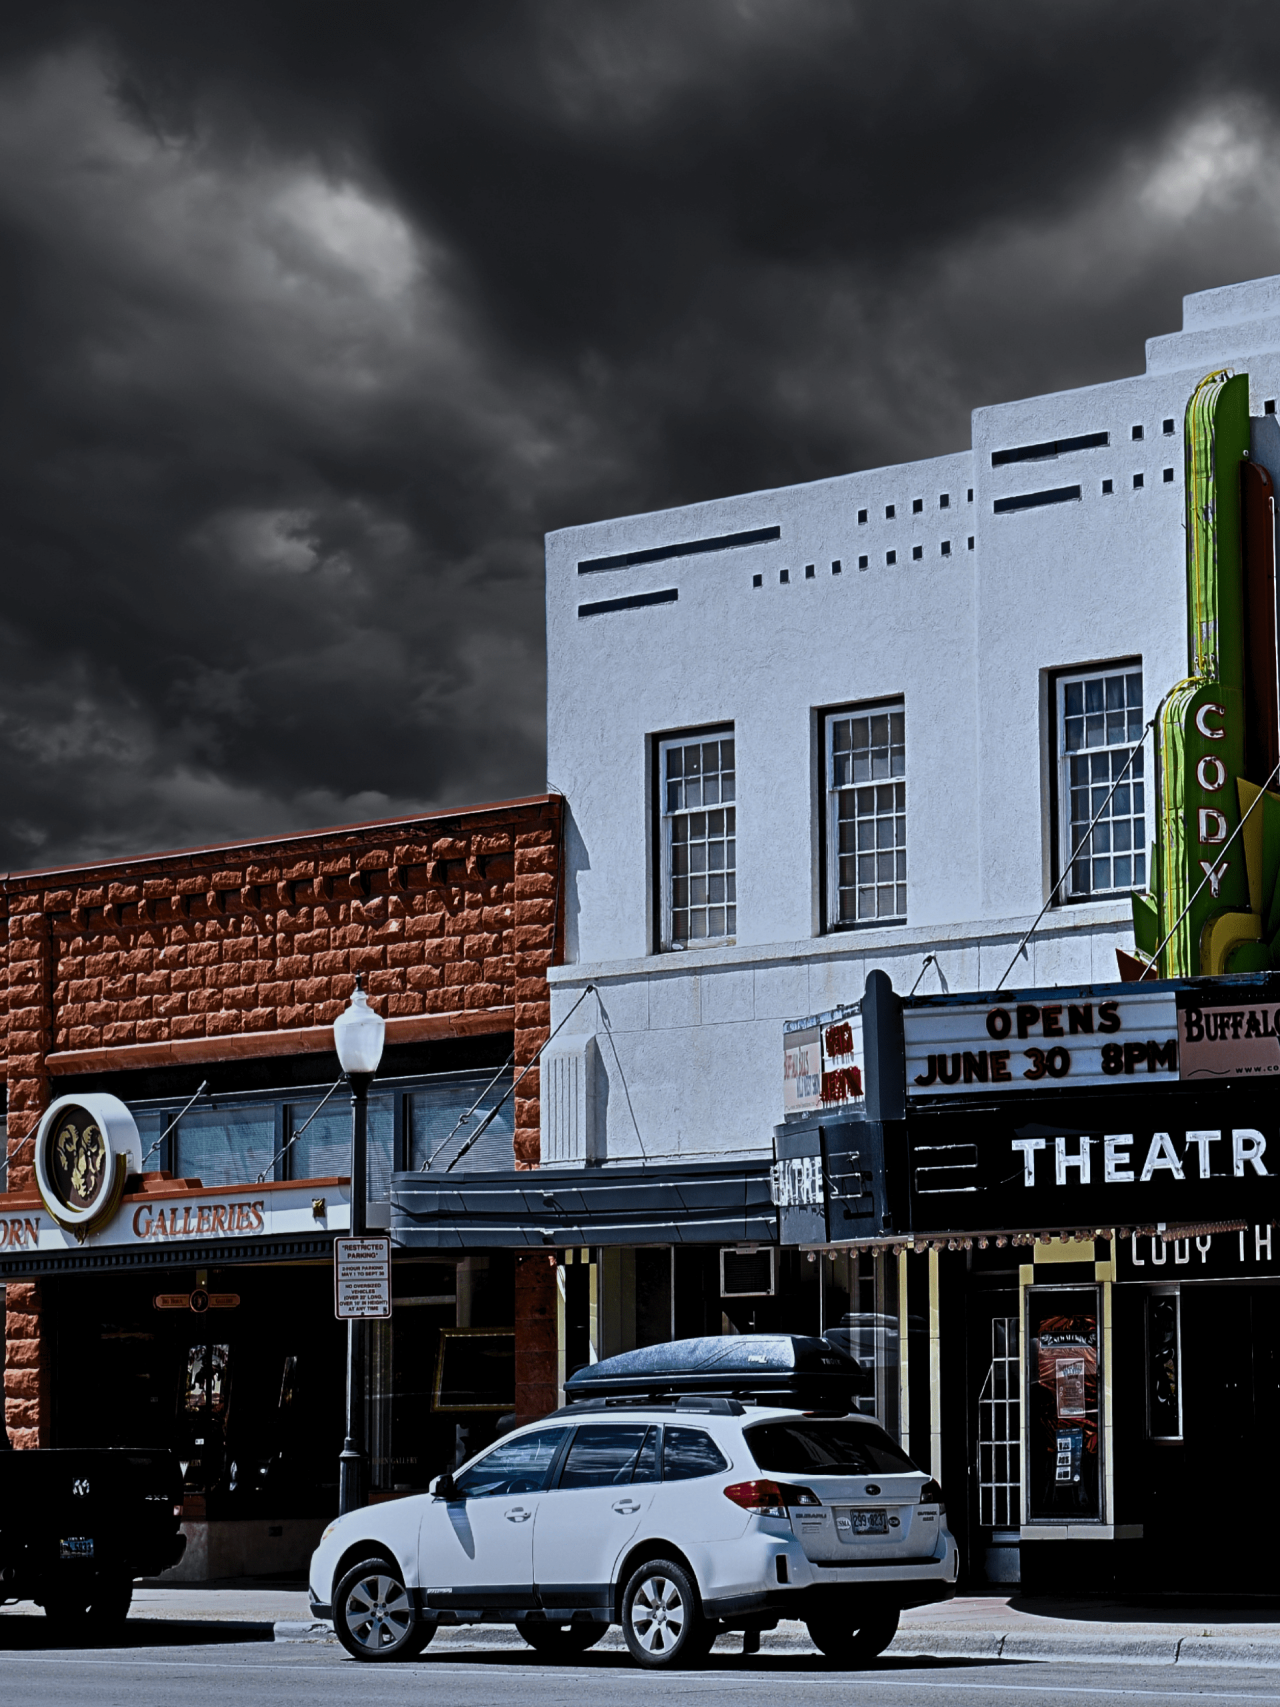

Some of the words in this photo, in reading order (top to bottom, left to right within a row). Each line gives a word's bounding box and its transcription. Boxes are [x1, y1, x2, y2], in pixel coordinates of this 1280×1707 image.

[1195, 702, 1230, 898] CODY
[986, 1001, 1121, 1040] OPENS
[914, 1050, 1012, 1086] JUNE
[1022, 1046, 1071, 1081] 30
[1101, 1039, 1177, 1075] 8PM
[133, 1201, 263, 1240] GALLERIES
